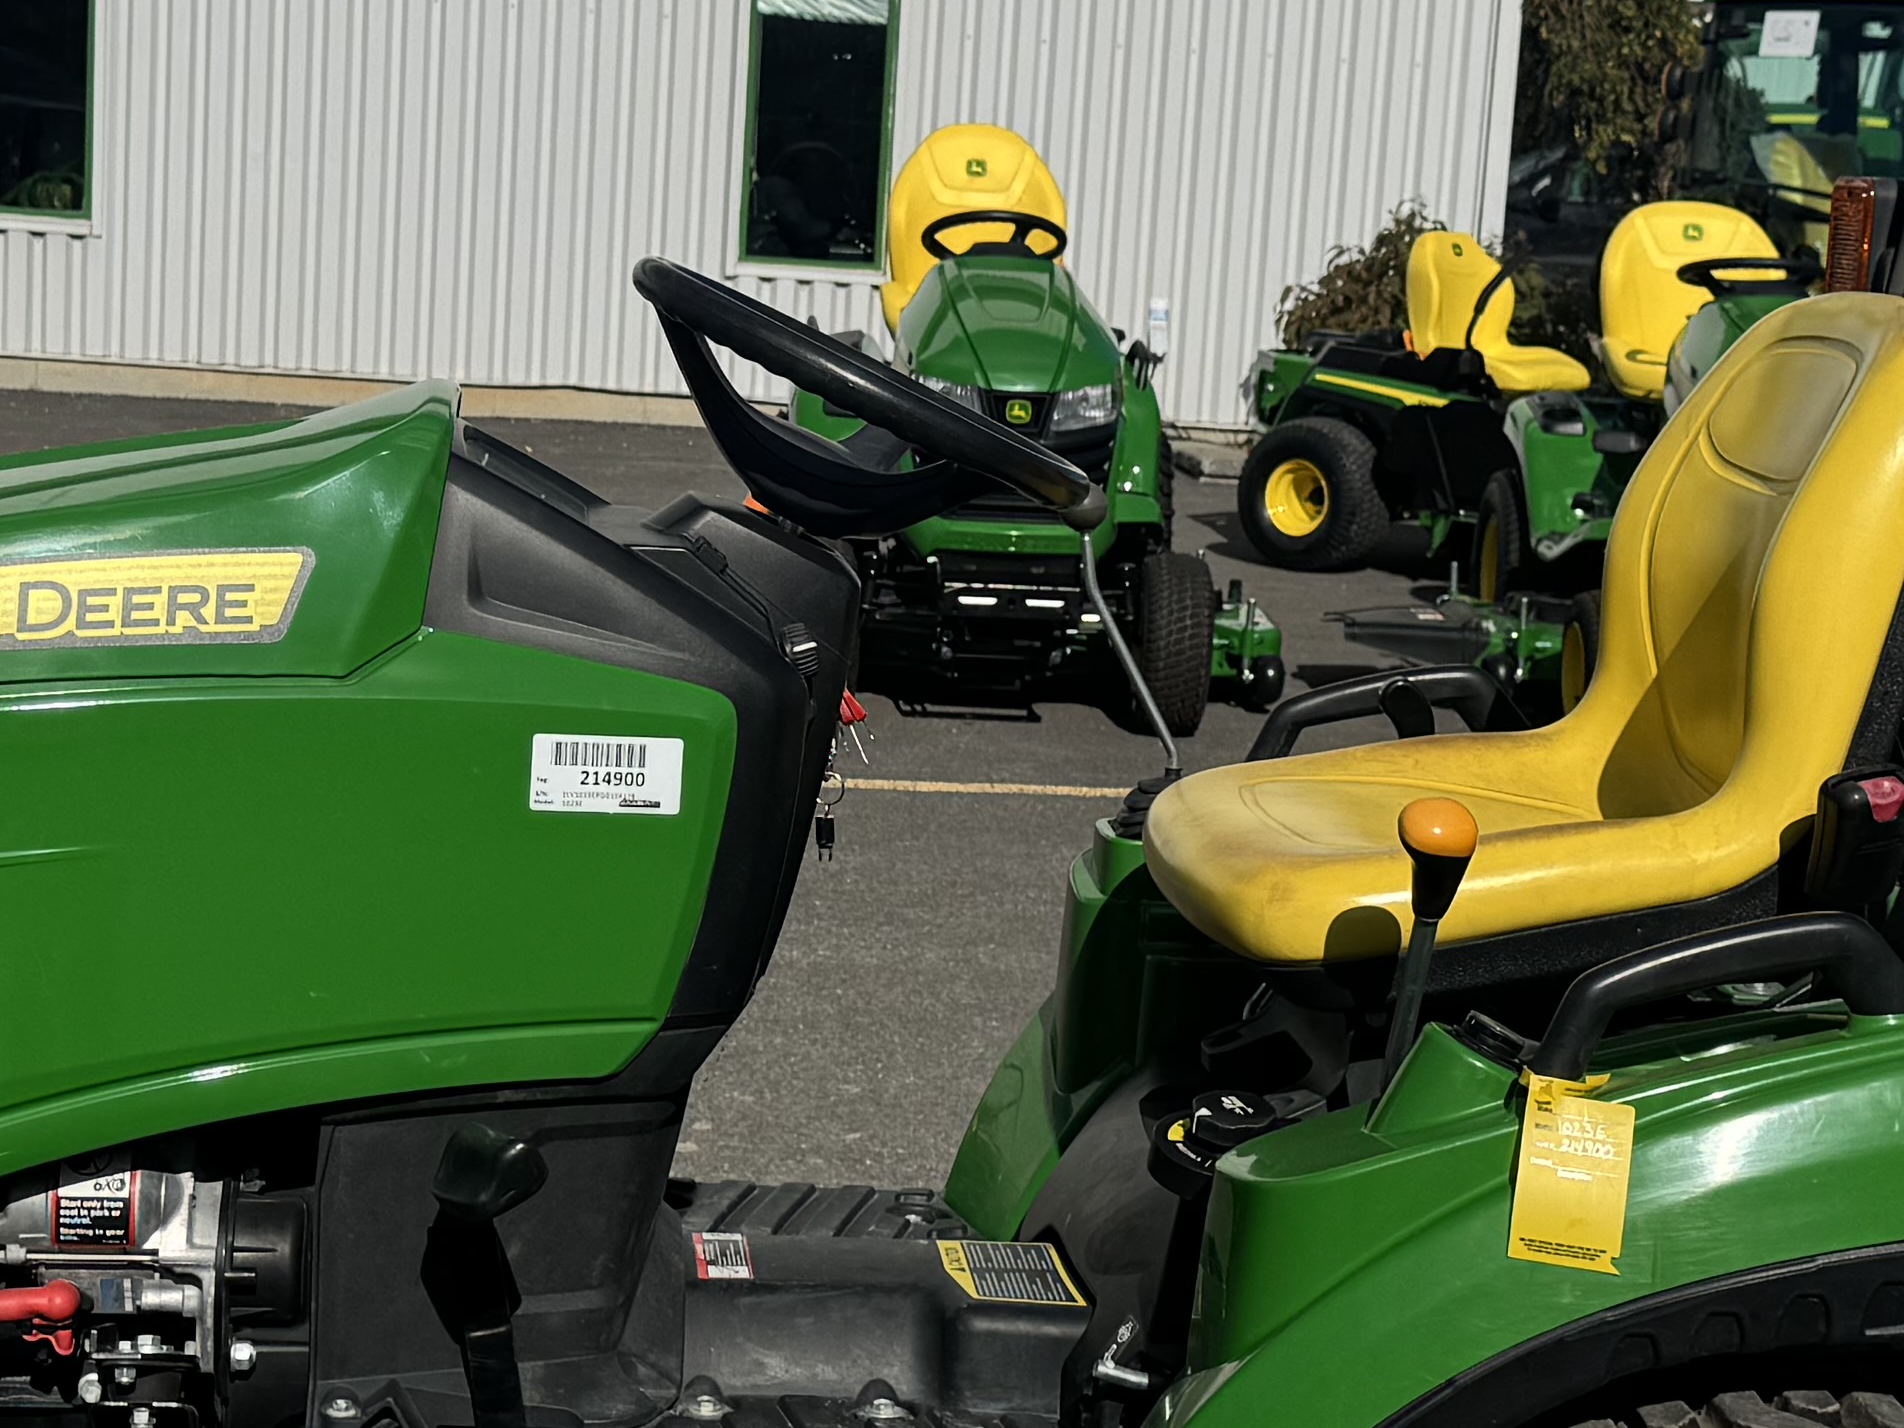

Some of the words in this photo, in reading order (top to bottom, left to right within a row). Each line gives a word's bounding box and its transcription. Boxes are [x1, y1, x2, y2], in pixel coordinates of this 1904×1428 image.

[16, 580, 256, 634] DEERE
[580, 771, 646, 787] 214900
[1559, 1138, 1615, 1158] 214900
